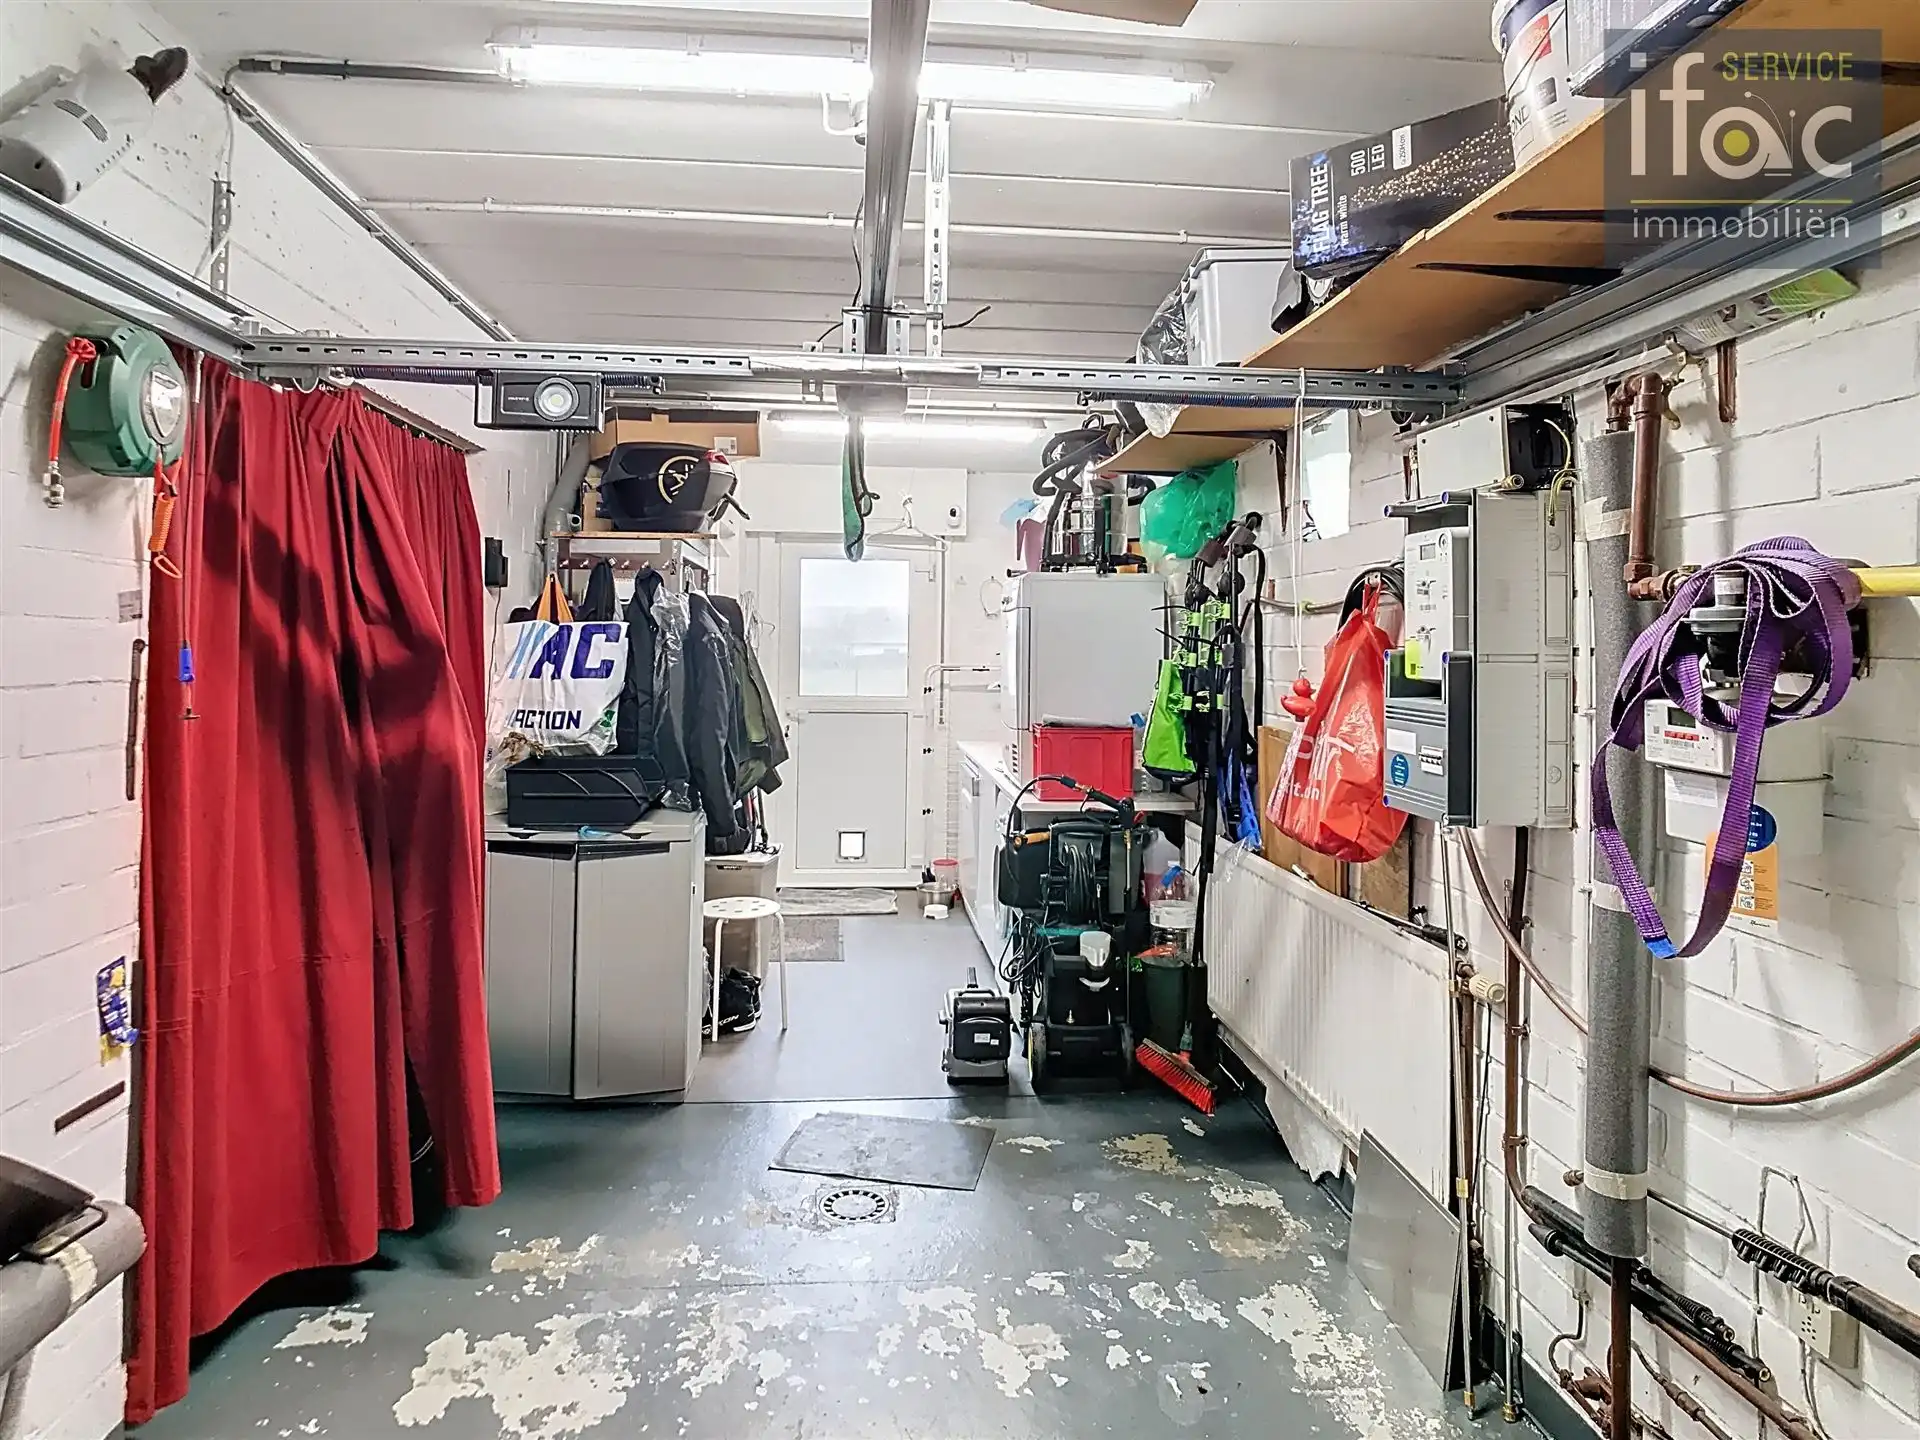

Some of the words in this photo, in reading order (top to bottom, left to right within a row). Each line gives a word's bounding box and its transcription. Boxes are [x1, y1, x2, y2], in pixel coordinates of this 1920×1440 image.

[1350, 149, 1366, 177] 500
[1371, 143, 1385, 171] LED
[1310, 163, 1329, 207] TREE
[1337, 194, 1348, 220] white
[1311, 208, 1332, 252] FLAG
[1340, 221, 1349, 248] warm
[514, 709, 582, 730] ACTION
